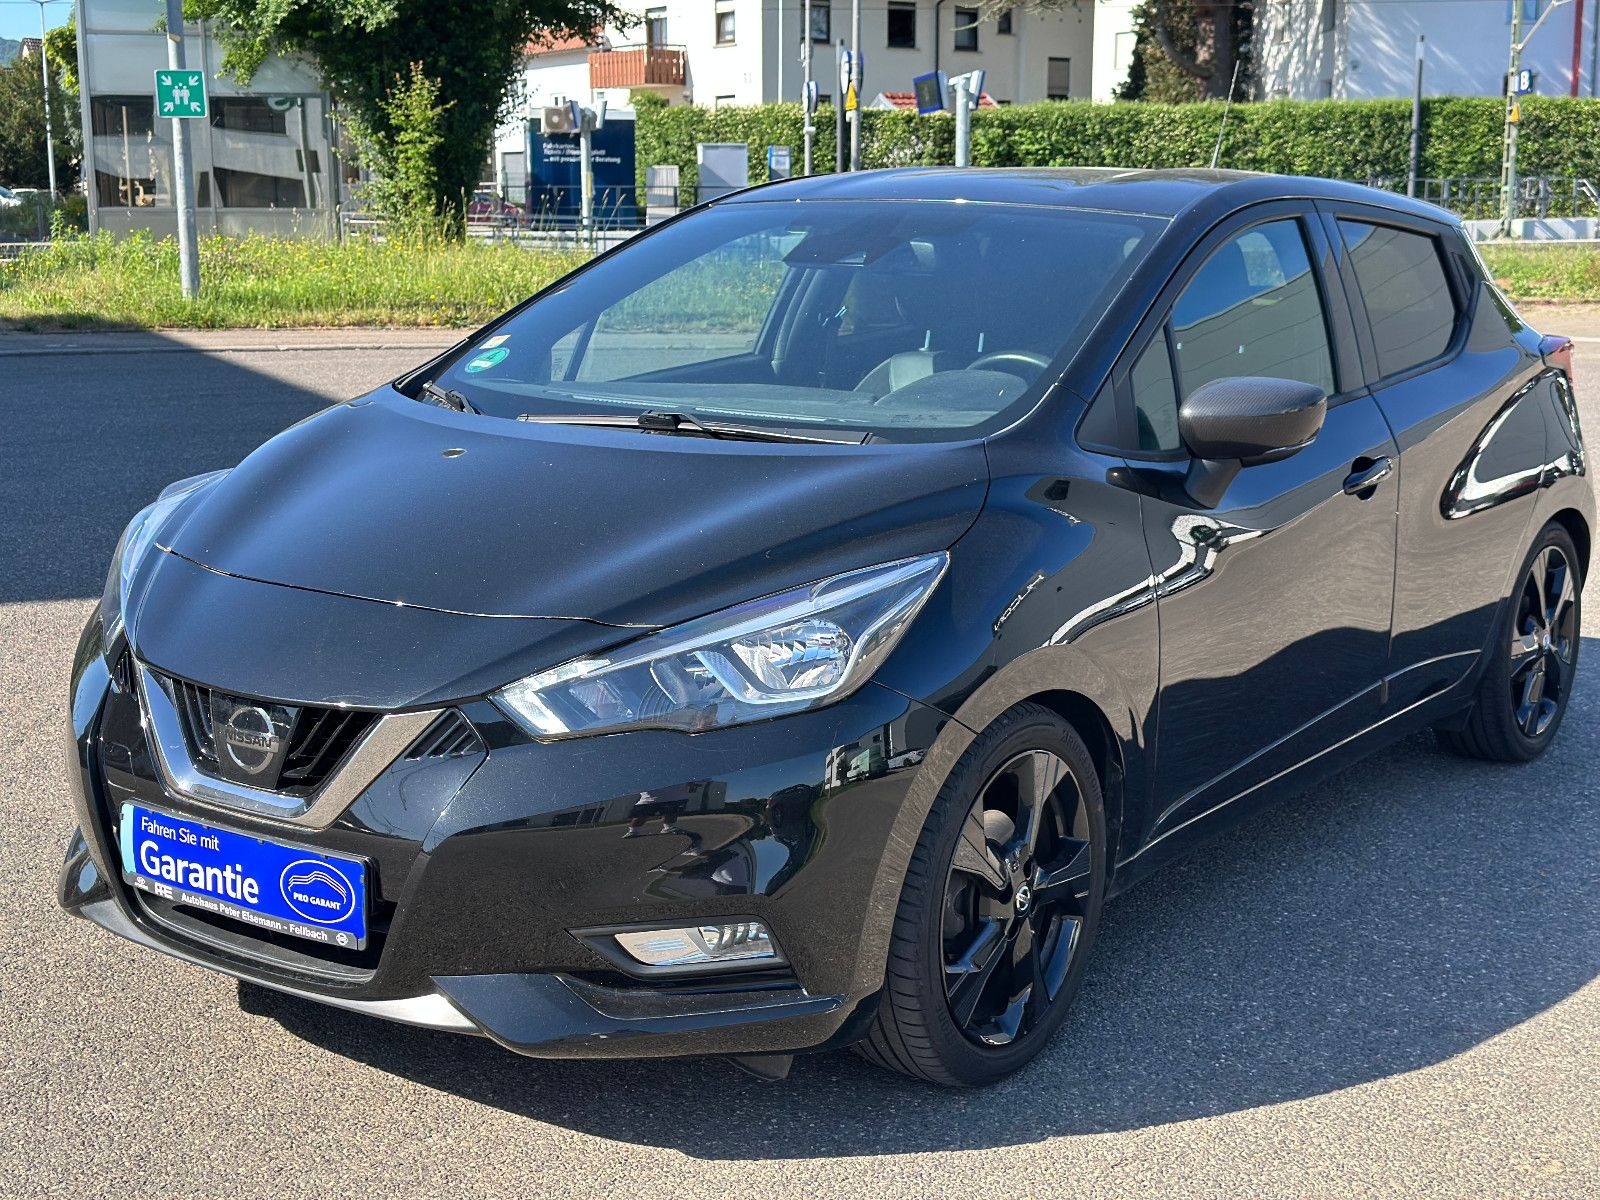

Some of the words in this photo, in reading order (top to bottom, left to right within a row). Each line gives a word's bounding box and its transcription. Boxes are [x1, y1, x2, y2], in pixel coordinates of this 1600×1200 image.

[1520, 71, 1530, 91] B
[226, 731, 272, 749] NISSAN
[141, 816, 176, 840] Fahren
[179, 827, 197, 846] Sie
[200, 834, 220, 851] mit
[140, 840, 259, 904] Garantie
[293, 892, 308, 903] PRO
[310, 896, 341, 910] GARANT
[181, 893, 219, 911] Autohaus
[219, 903, 240, 918] Peter
[289, 924, 328, 941] Fellbach
